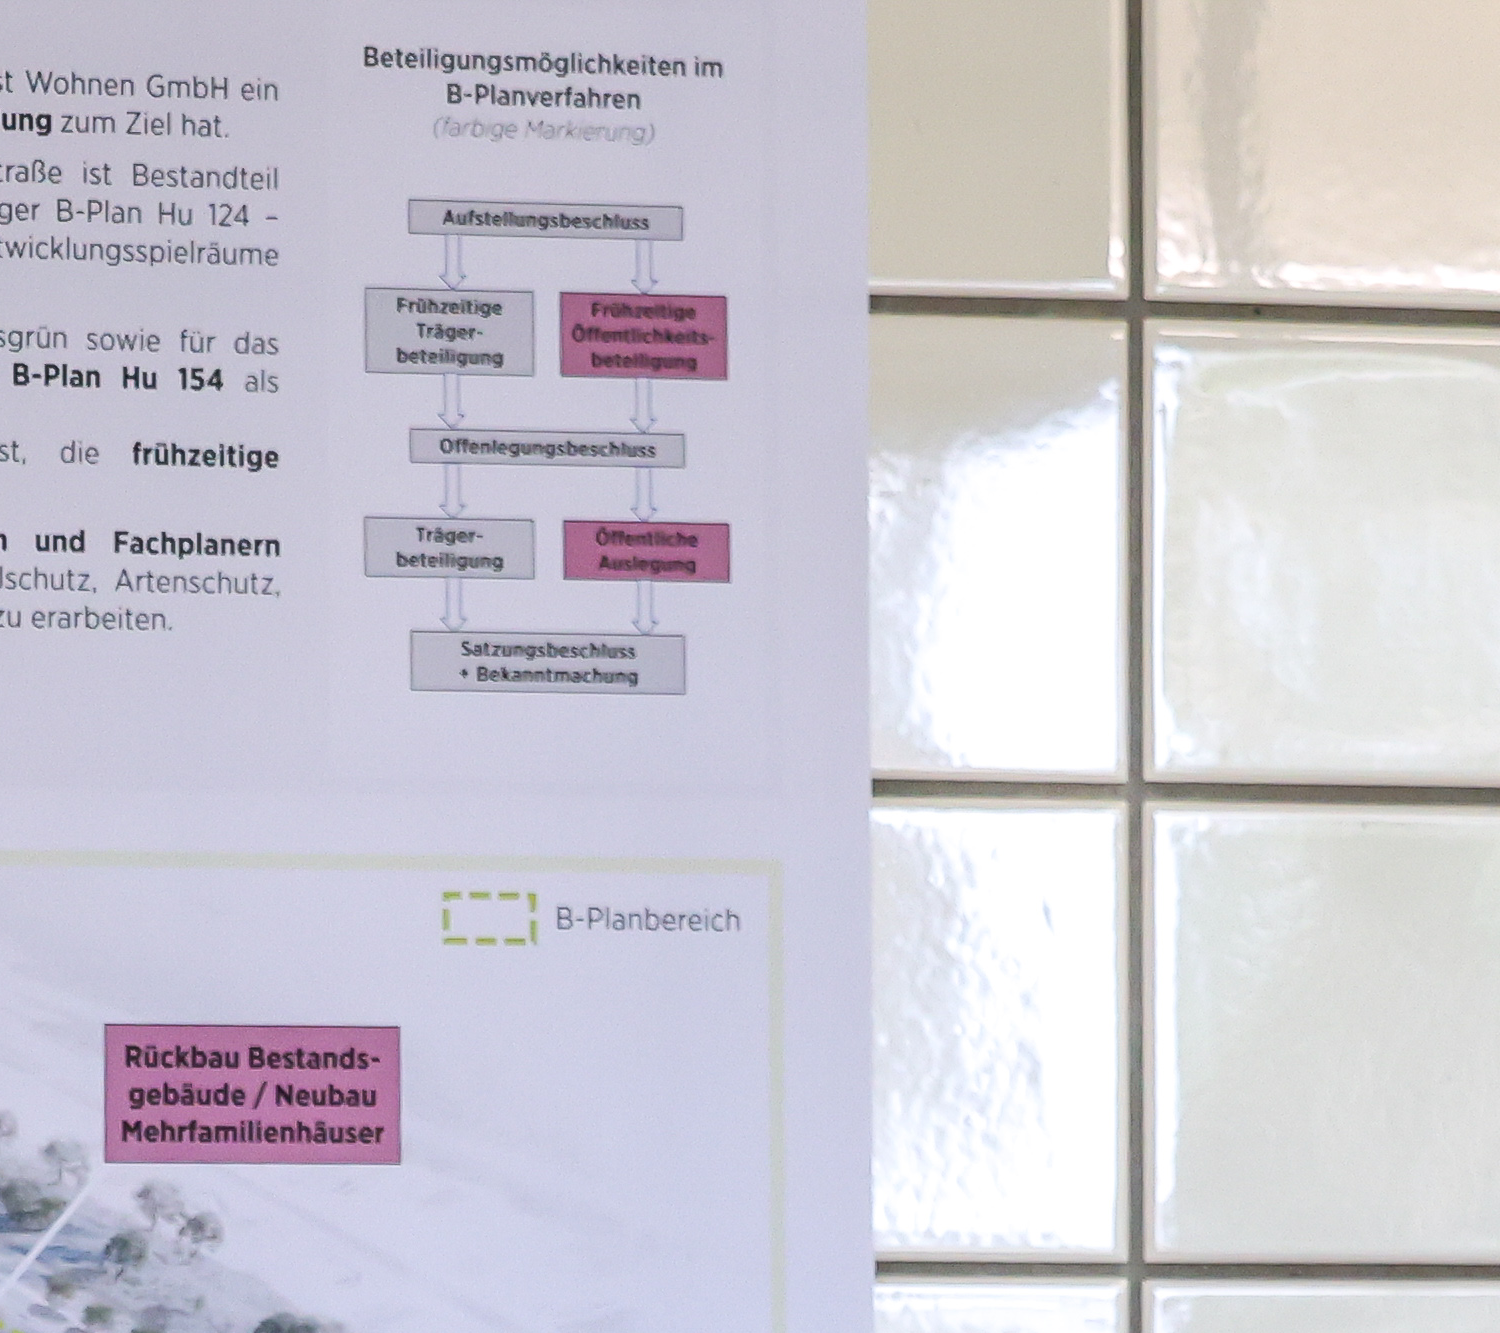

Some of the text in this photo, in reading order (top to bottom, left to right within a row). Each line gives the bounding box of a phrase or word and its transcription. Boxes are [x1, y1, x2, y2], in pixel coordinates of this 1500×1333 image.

[363, 45, 724, 79] Beteiligungsmöglichkeiten im
[25, 70, 134, 96] Wohnen
[146, 74, 228, 99] GmbH
[241, 83, 278, 101] ein
[446, 82, 641, 110] B-Planverfahren
[442, 209, 650, 231] Aufstellungsbeschluss
[396, 296, 503, 319] Frühzeitige
[590, 301, 698, 323] Frühzeitige
[416, 322, 484, 343] Träger-
[570, 322, 715, 346] Öffentlichkeits-
[396, 346, 504, 369] beteiligung
[590, 351, 698, 376] beteiligung
[439, 437, 657, 460] Offenlegungsbeschluss
[415, 526, 484, 547] Träger-
[595, 524, 699, 548] Öffentliche
[395, 551, 504, 573] beteiligung
[597, 554, 697, 577] Auslegung
[460, 640, 636, 661] Satzungsbeschluss
[476, 665, 639, 688] Bekanntmachung
[556, 905, 741, 933] B-Planbereich
[124, 1044, 381, 1070] Rückbau Bestands-
[128, 1081, 247, 1110] gebäude
[274, 1083, 377, 1108] Neubau
[121, 1119, 385, 1145] Mehrfamilienhäuser
